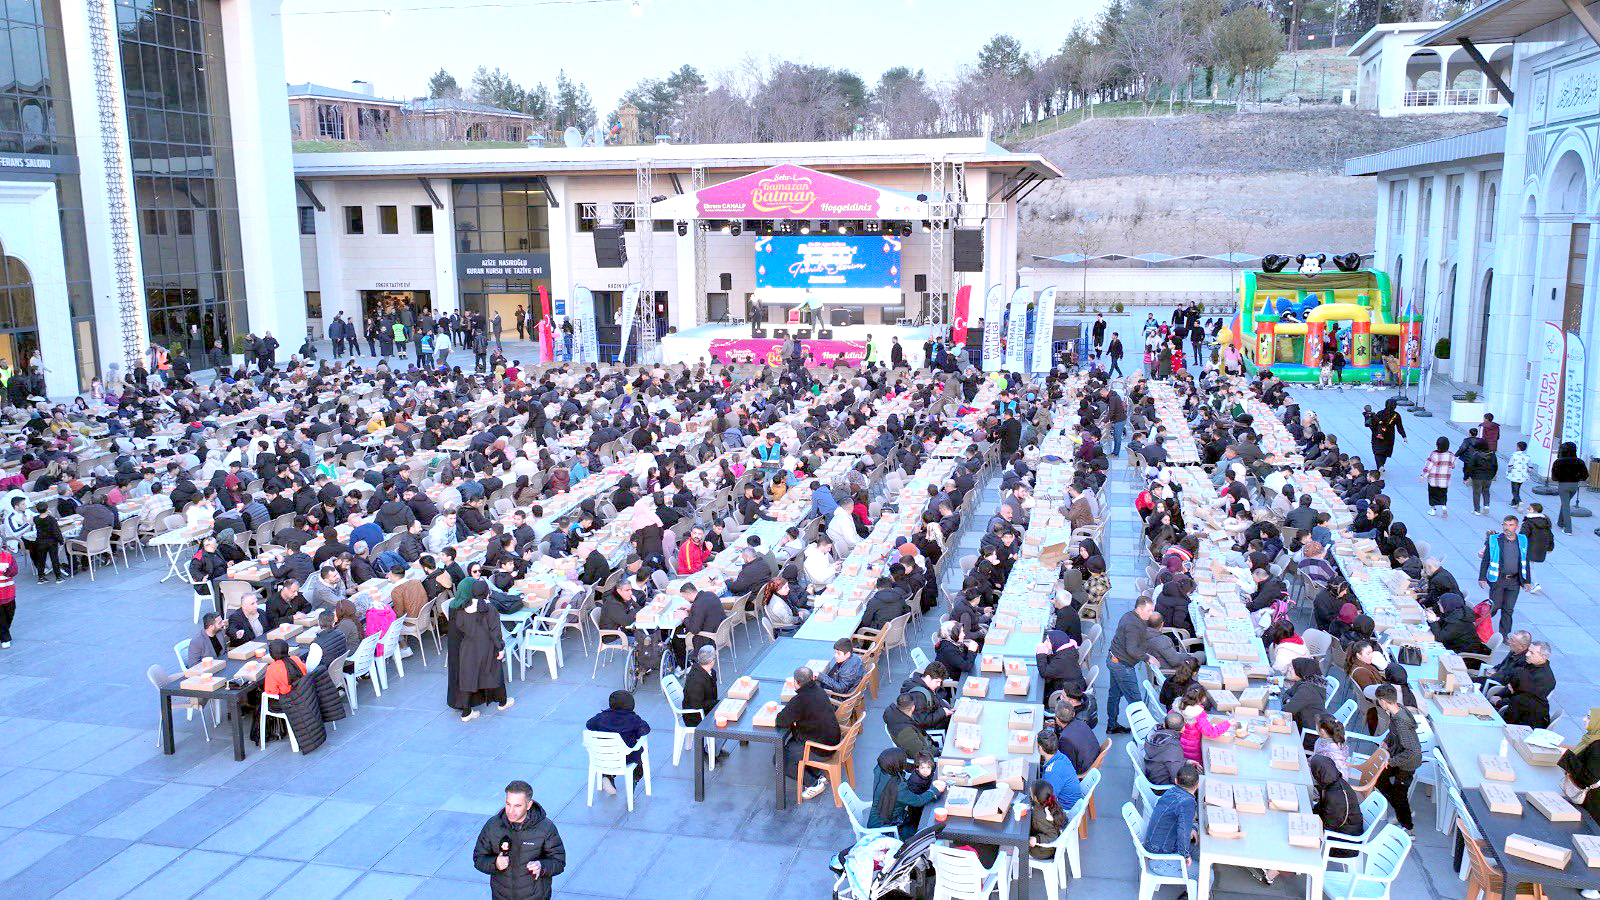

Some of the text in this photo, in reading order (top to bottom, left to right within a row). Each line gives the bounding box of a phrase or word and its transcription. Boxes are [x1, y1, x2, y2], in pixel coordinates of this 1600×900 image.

[750, 188, 815, 203] Batman
[820, 202, 873, 214] Hoşgeldiniz
[984, 321, 992, 360] BATMAN
[1007, 320, 1017, 357] BATMAN
[1016, 314, 1025, 362] BELEDİYESİ
